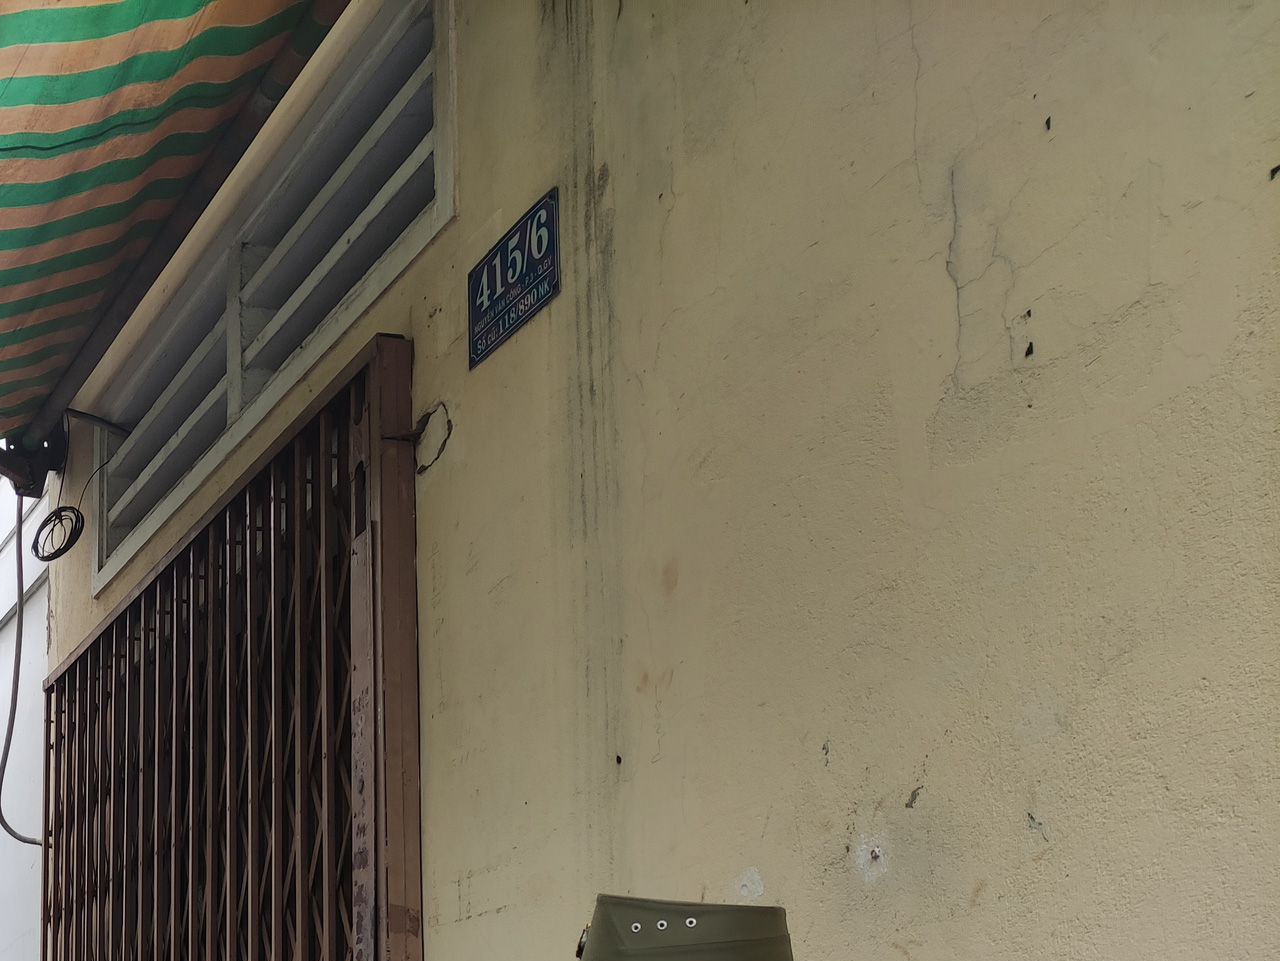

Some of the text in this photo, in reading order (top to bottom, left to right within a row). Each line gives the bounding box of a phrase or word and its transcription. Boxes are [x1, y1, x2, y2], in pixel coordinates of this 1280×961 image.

[475, 209, 549, 312] 415/6
[506, 284, 523, 303] CÔNG
[477, 334, 487, 355] Số
[498, 288, 538, 334] 118/890
[538, 277, 551, 300] NK
